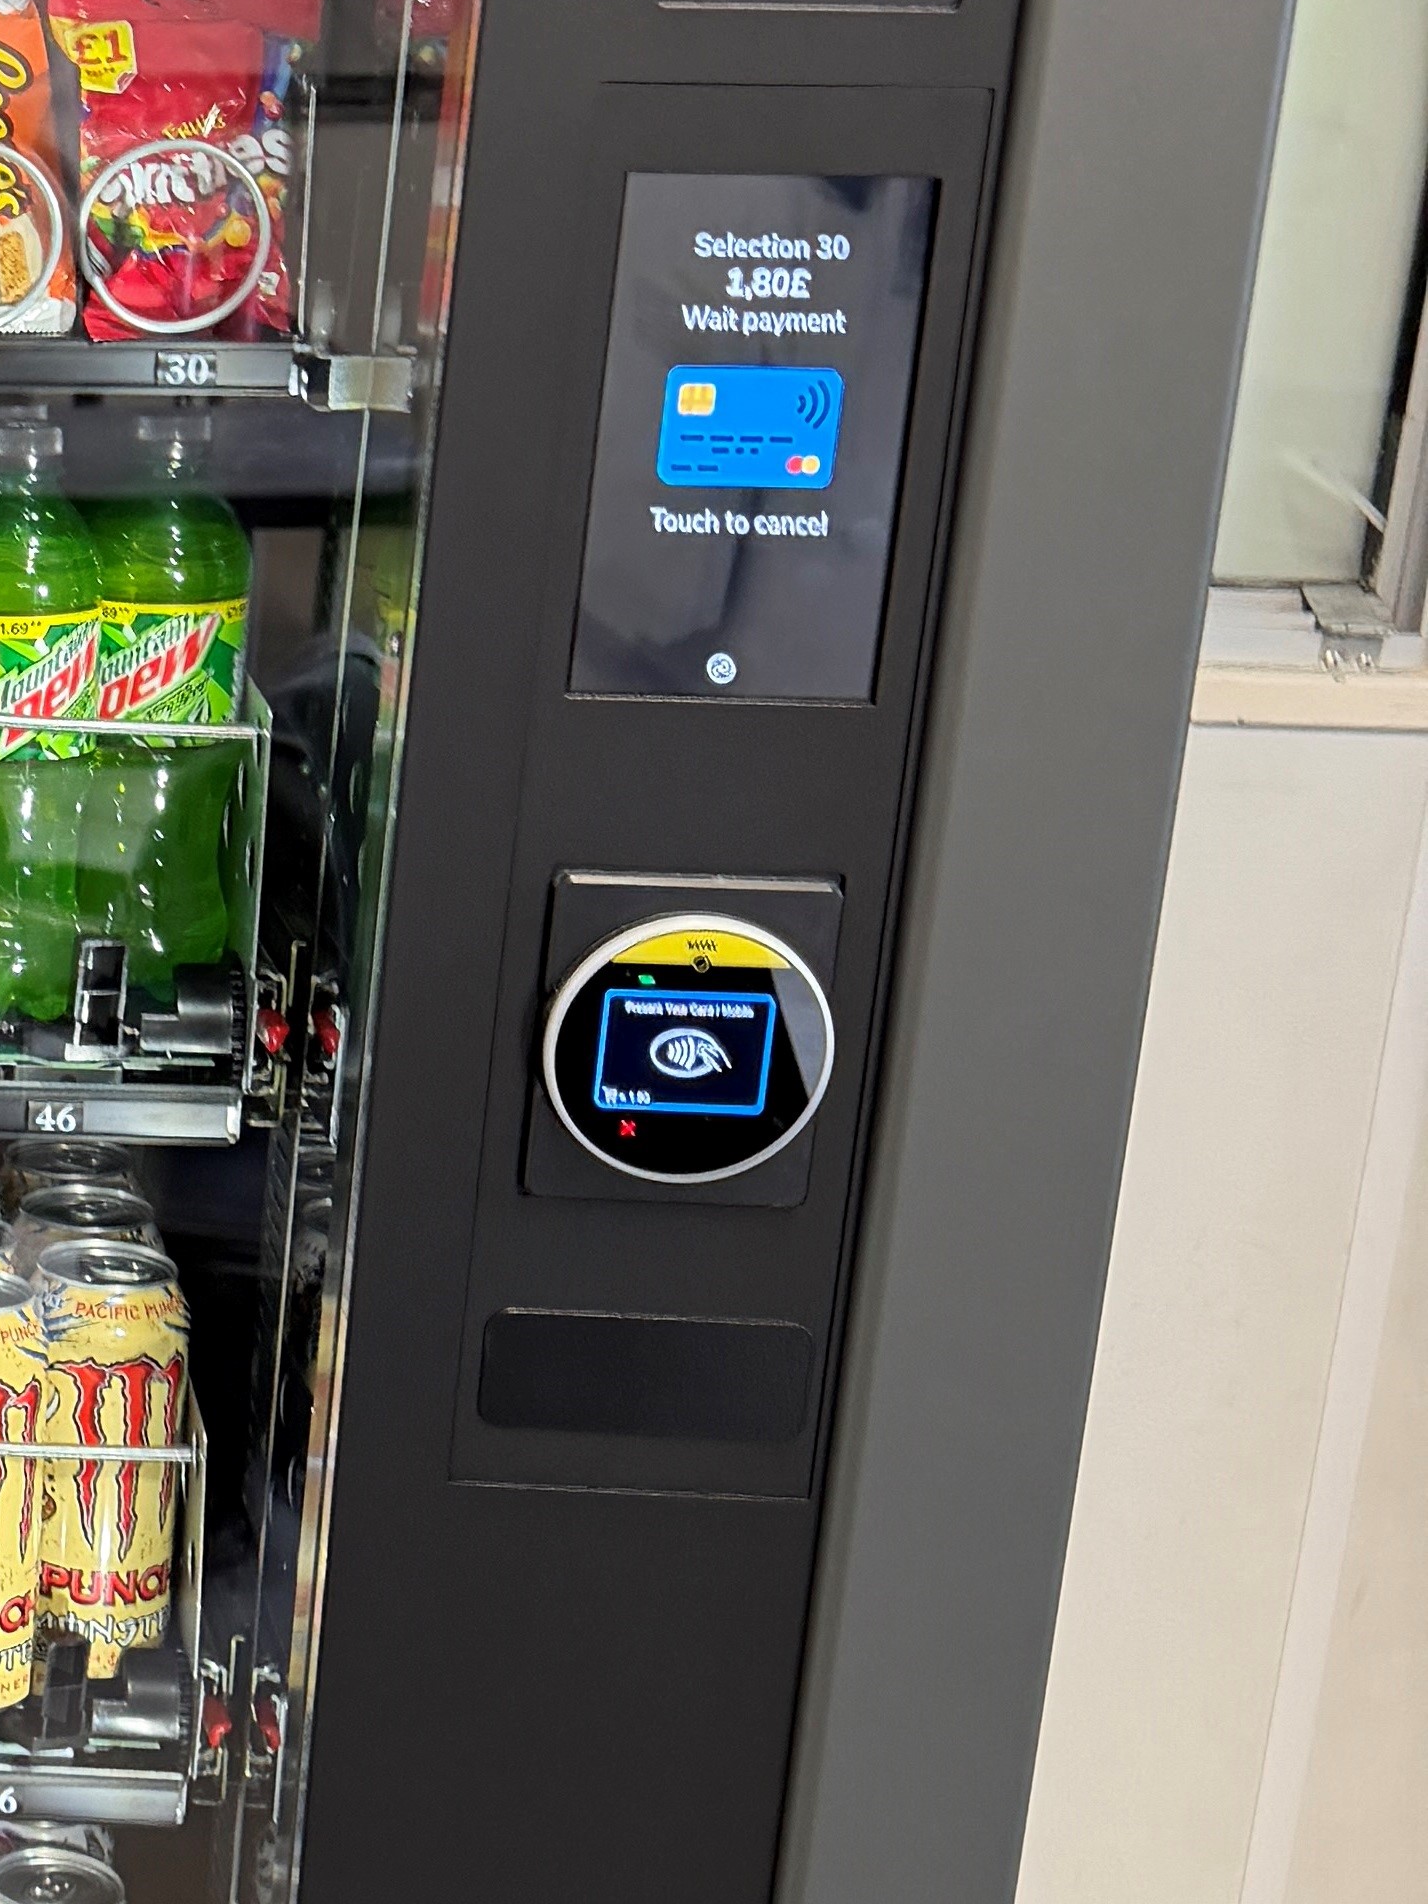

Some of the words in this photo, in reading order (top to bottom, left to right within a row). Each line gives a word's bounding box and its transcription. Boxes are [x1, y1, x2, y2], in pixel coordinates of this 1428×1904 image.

[693, 231, 812, 262] Selection
[815, 233, 851, 262] 30
[680, 304, 741, 334] Wait
[741, 308, 849, 338] payment
[164, 354, 211, 387] 30
[649, 505, 720, 537] Touch
[724, 510, 751, 538] to
[752, 511, 829, 539] cancel
[35, 1106, 78, 1133] 46
